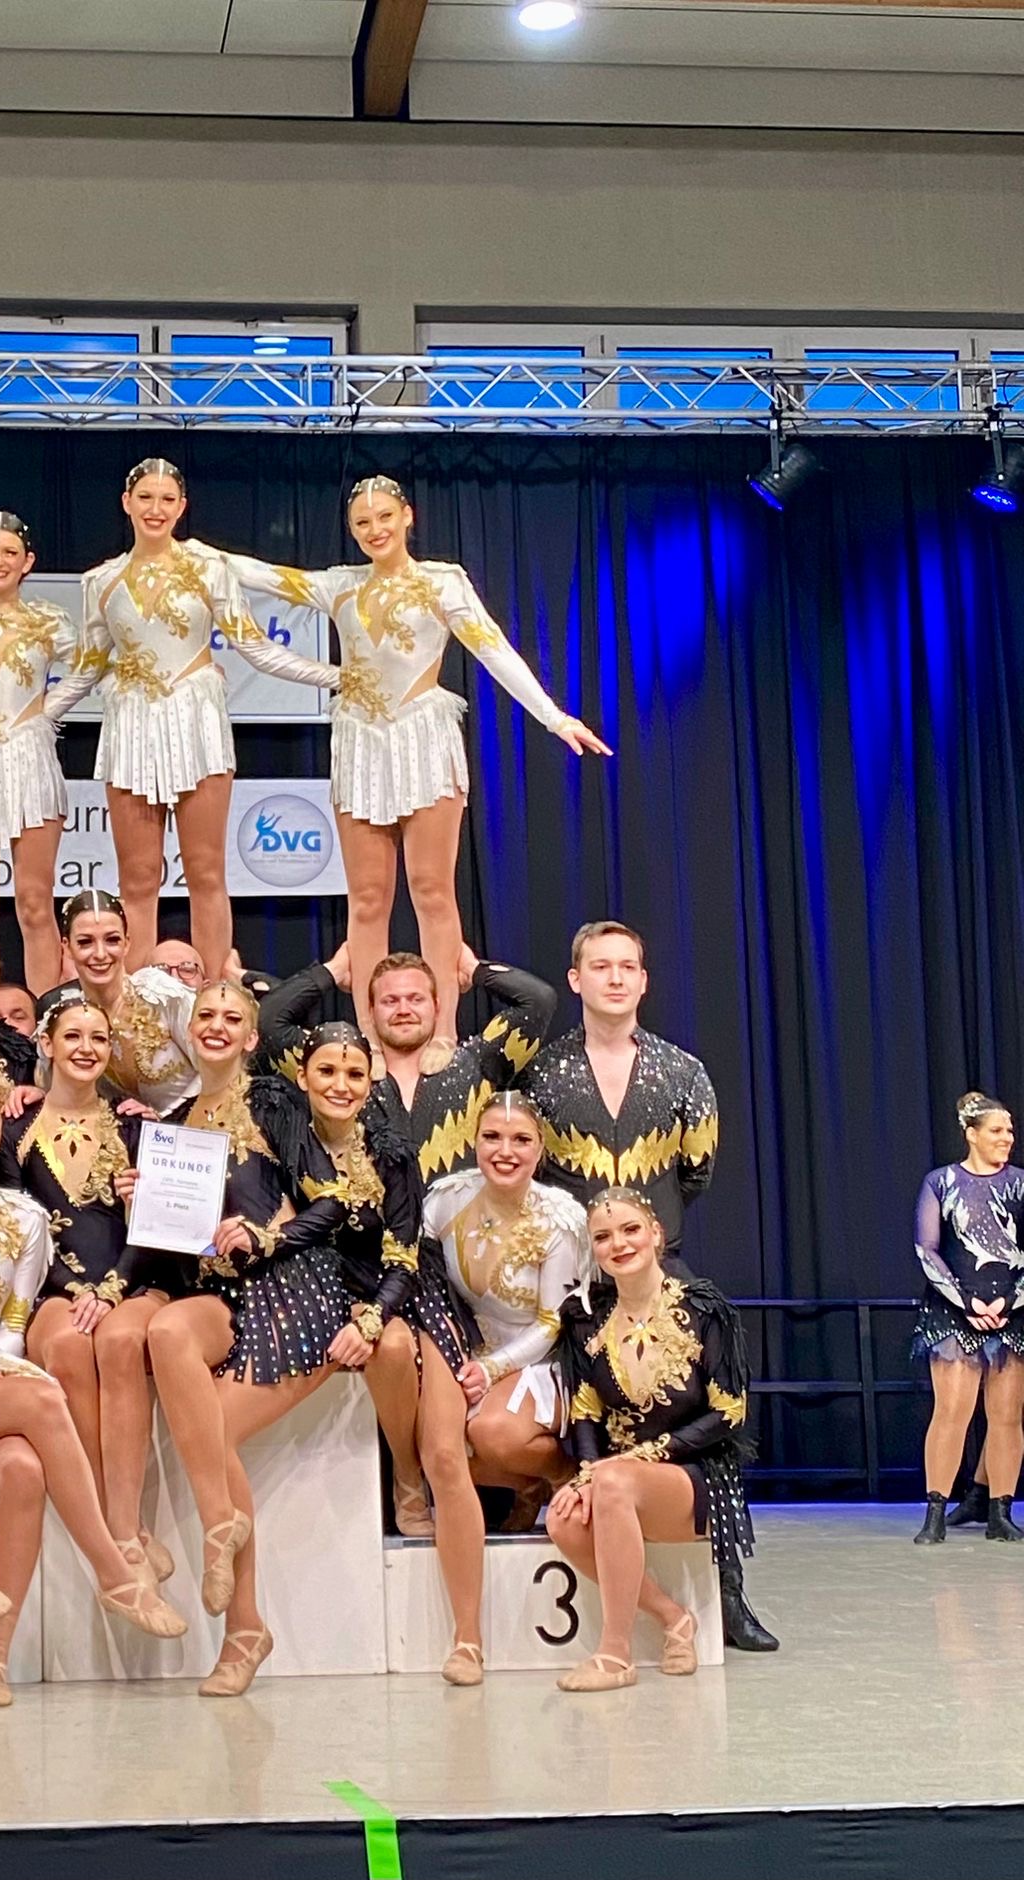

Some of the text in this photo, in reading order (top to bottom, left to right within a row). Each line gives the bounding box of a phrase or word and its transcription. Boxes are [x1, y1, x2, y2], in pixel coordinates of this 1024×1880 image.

[262, 830, 321, 852] DVG
[155, 1132, 174, 1144] DVG
[152, 1157, 212, 1174] URKUNDE
[533, 1560, 579, 1646] 3
